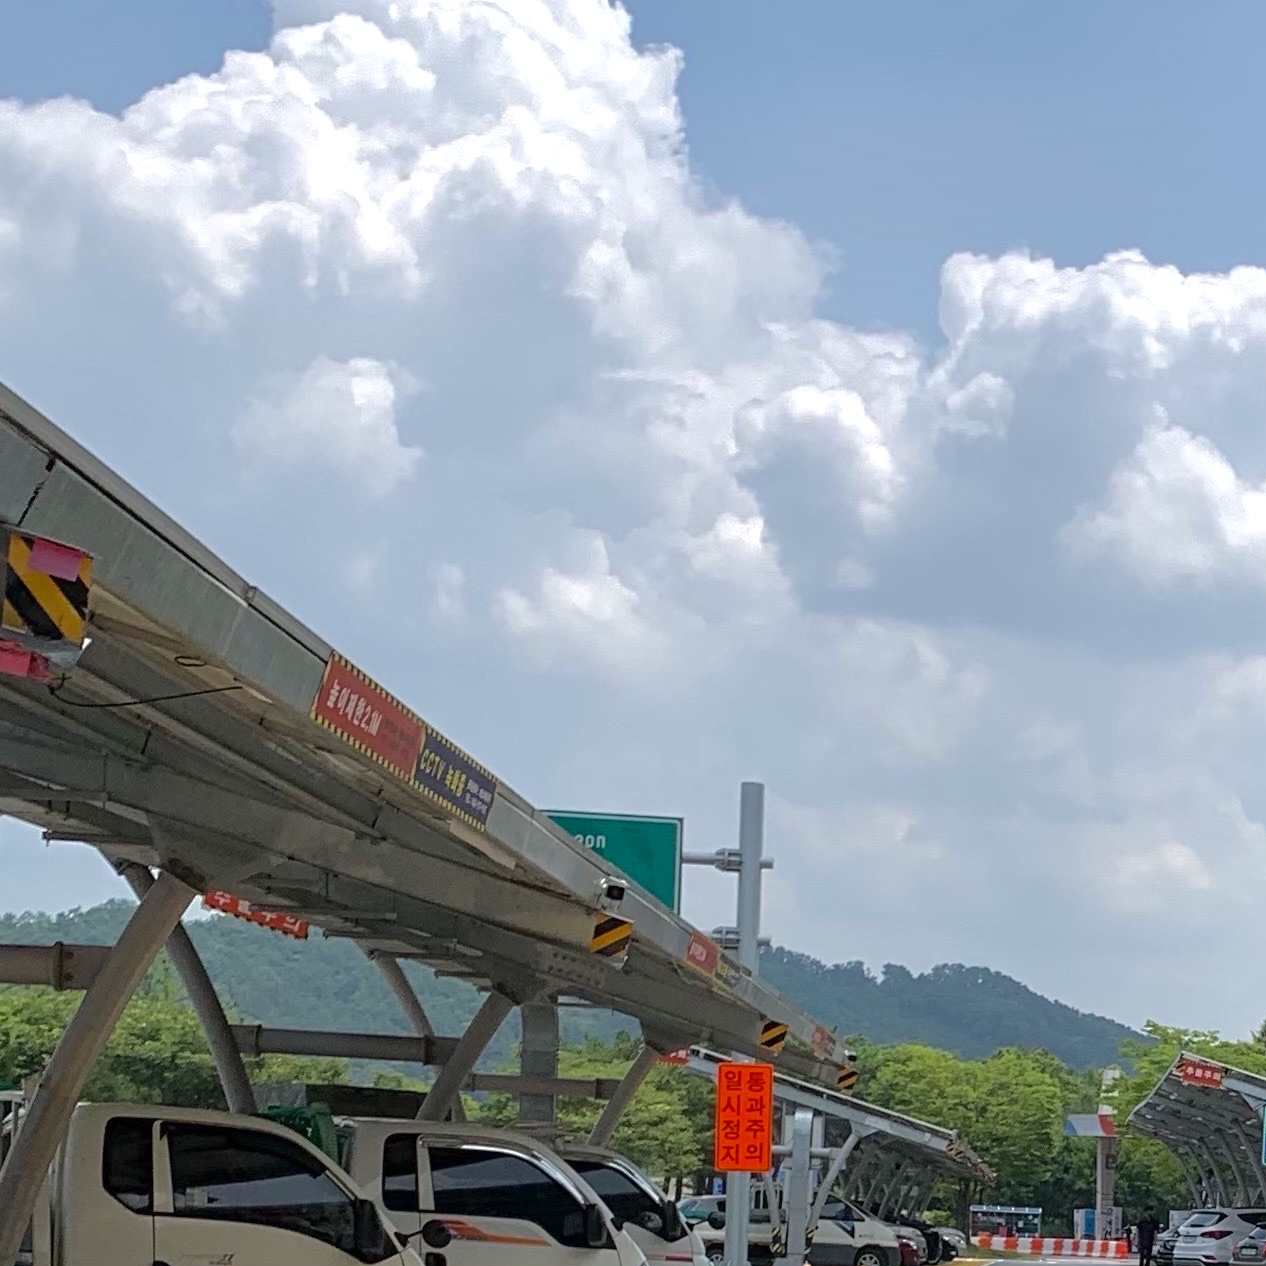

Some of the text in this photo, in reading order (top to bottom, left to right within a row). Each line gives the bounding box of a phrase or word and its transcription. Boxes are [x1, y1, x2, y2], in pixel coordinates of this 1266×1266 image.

[420, 748, 446, 781] CCTV
[720, 1070, 743, 1165] 일시정지
[744, 1071, 767, 1163] 통과주의
